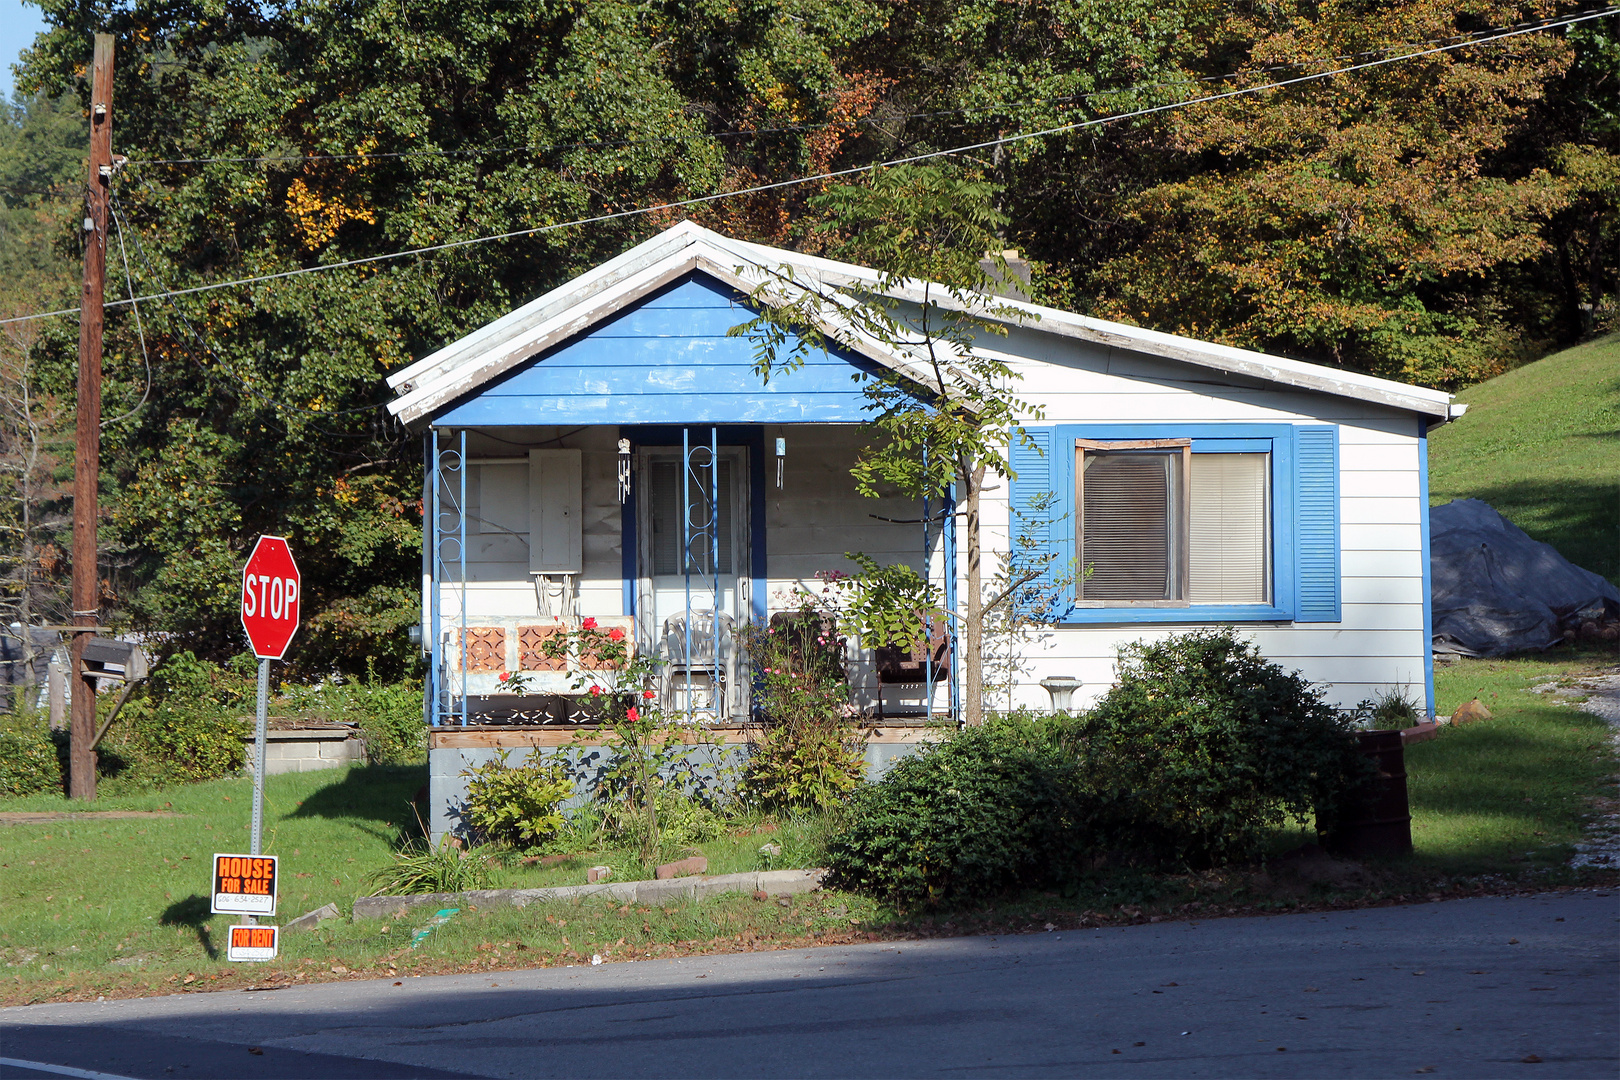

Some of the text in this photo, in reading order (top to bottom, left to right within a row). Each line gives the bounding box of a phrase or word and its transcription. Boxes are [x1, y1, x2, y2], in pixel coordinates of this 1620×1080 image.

[244, 573, 297, 620] STOP
[218, 857, 273, 879] HOUSE
[221, 878, 269, 894] FOR SALE
[232, 928, 274, 948] FOR RENT
